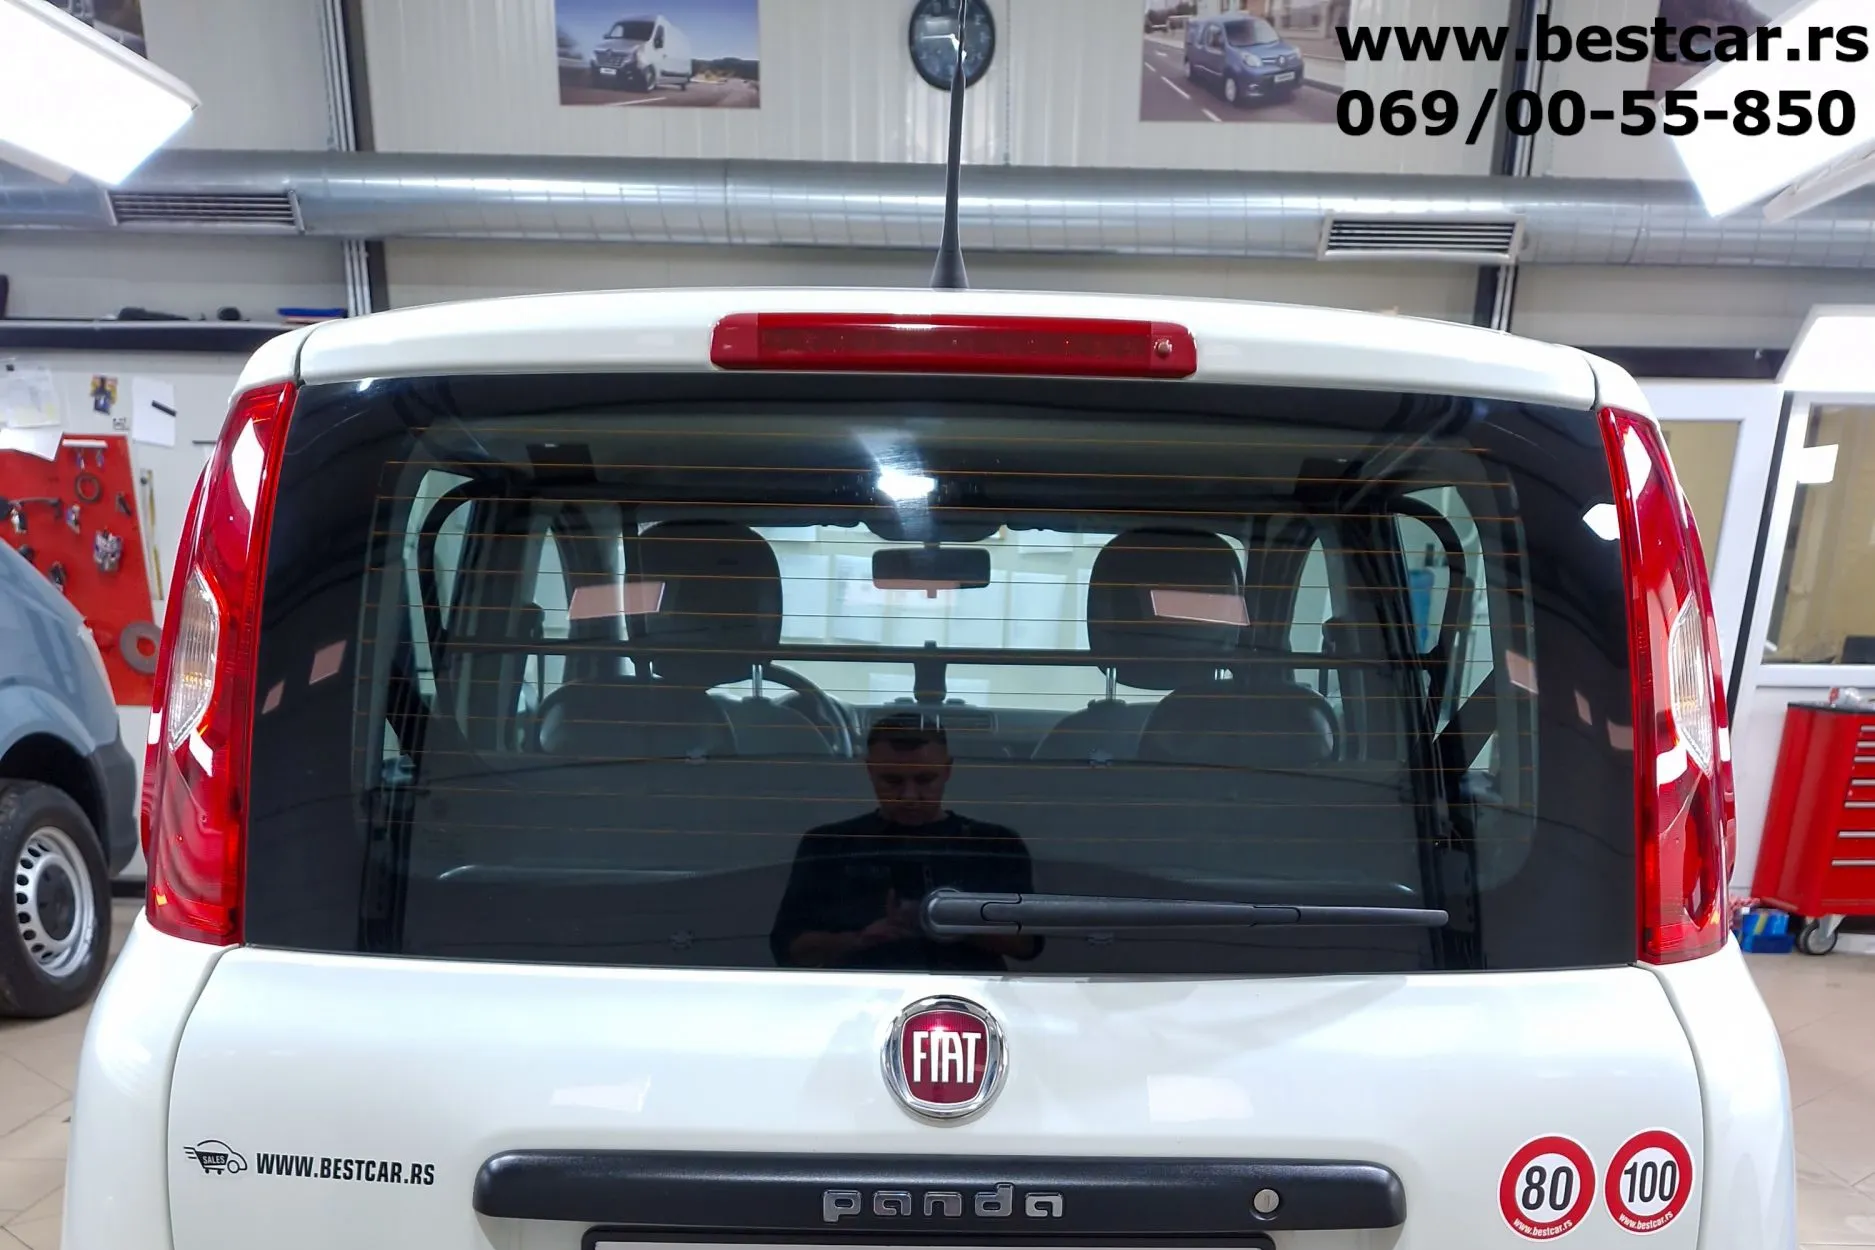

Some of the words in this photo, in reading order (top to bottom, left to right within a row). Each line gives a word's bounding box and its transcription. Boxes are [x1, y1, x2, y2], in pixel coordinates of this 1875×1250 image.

[912, 1030, 981, 1084] FIAT
[202, 1155, 225, 1165] SALES
[256, 1153, 435, 1185] WWW.BESTCAR.RS
[1521, 1165, 1574, 1211] 80
[1623, 1160, 1678, 1203] 100
[822, 1182, 1065, 1222] panda
[1513, 1218, 1573, 1236] www.bestcar.rs
[1618, 1211, 1673, 1230] www.bestcar.rs
